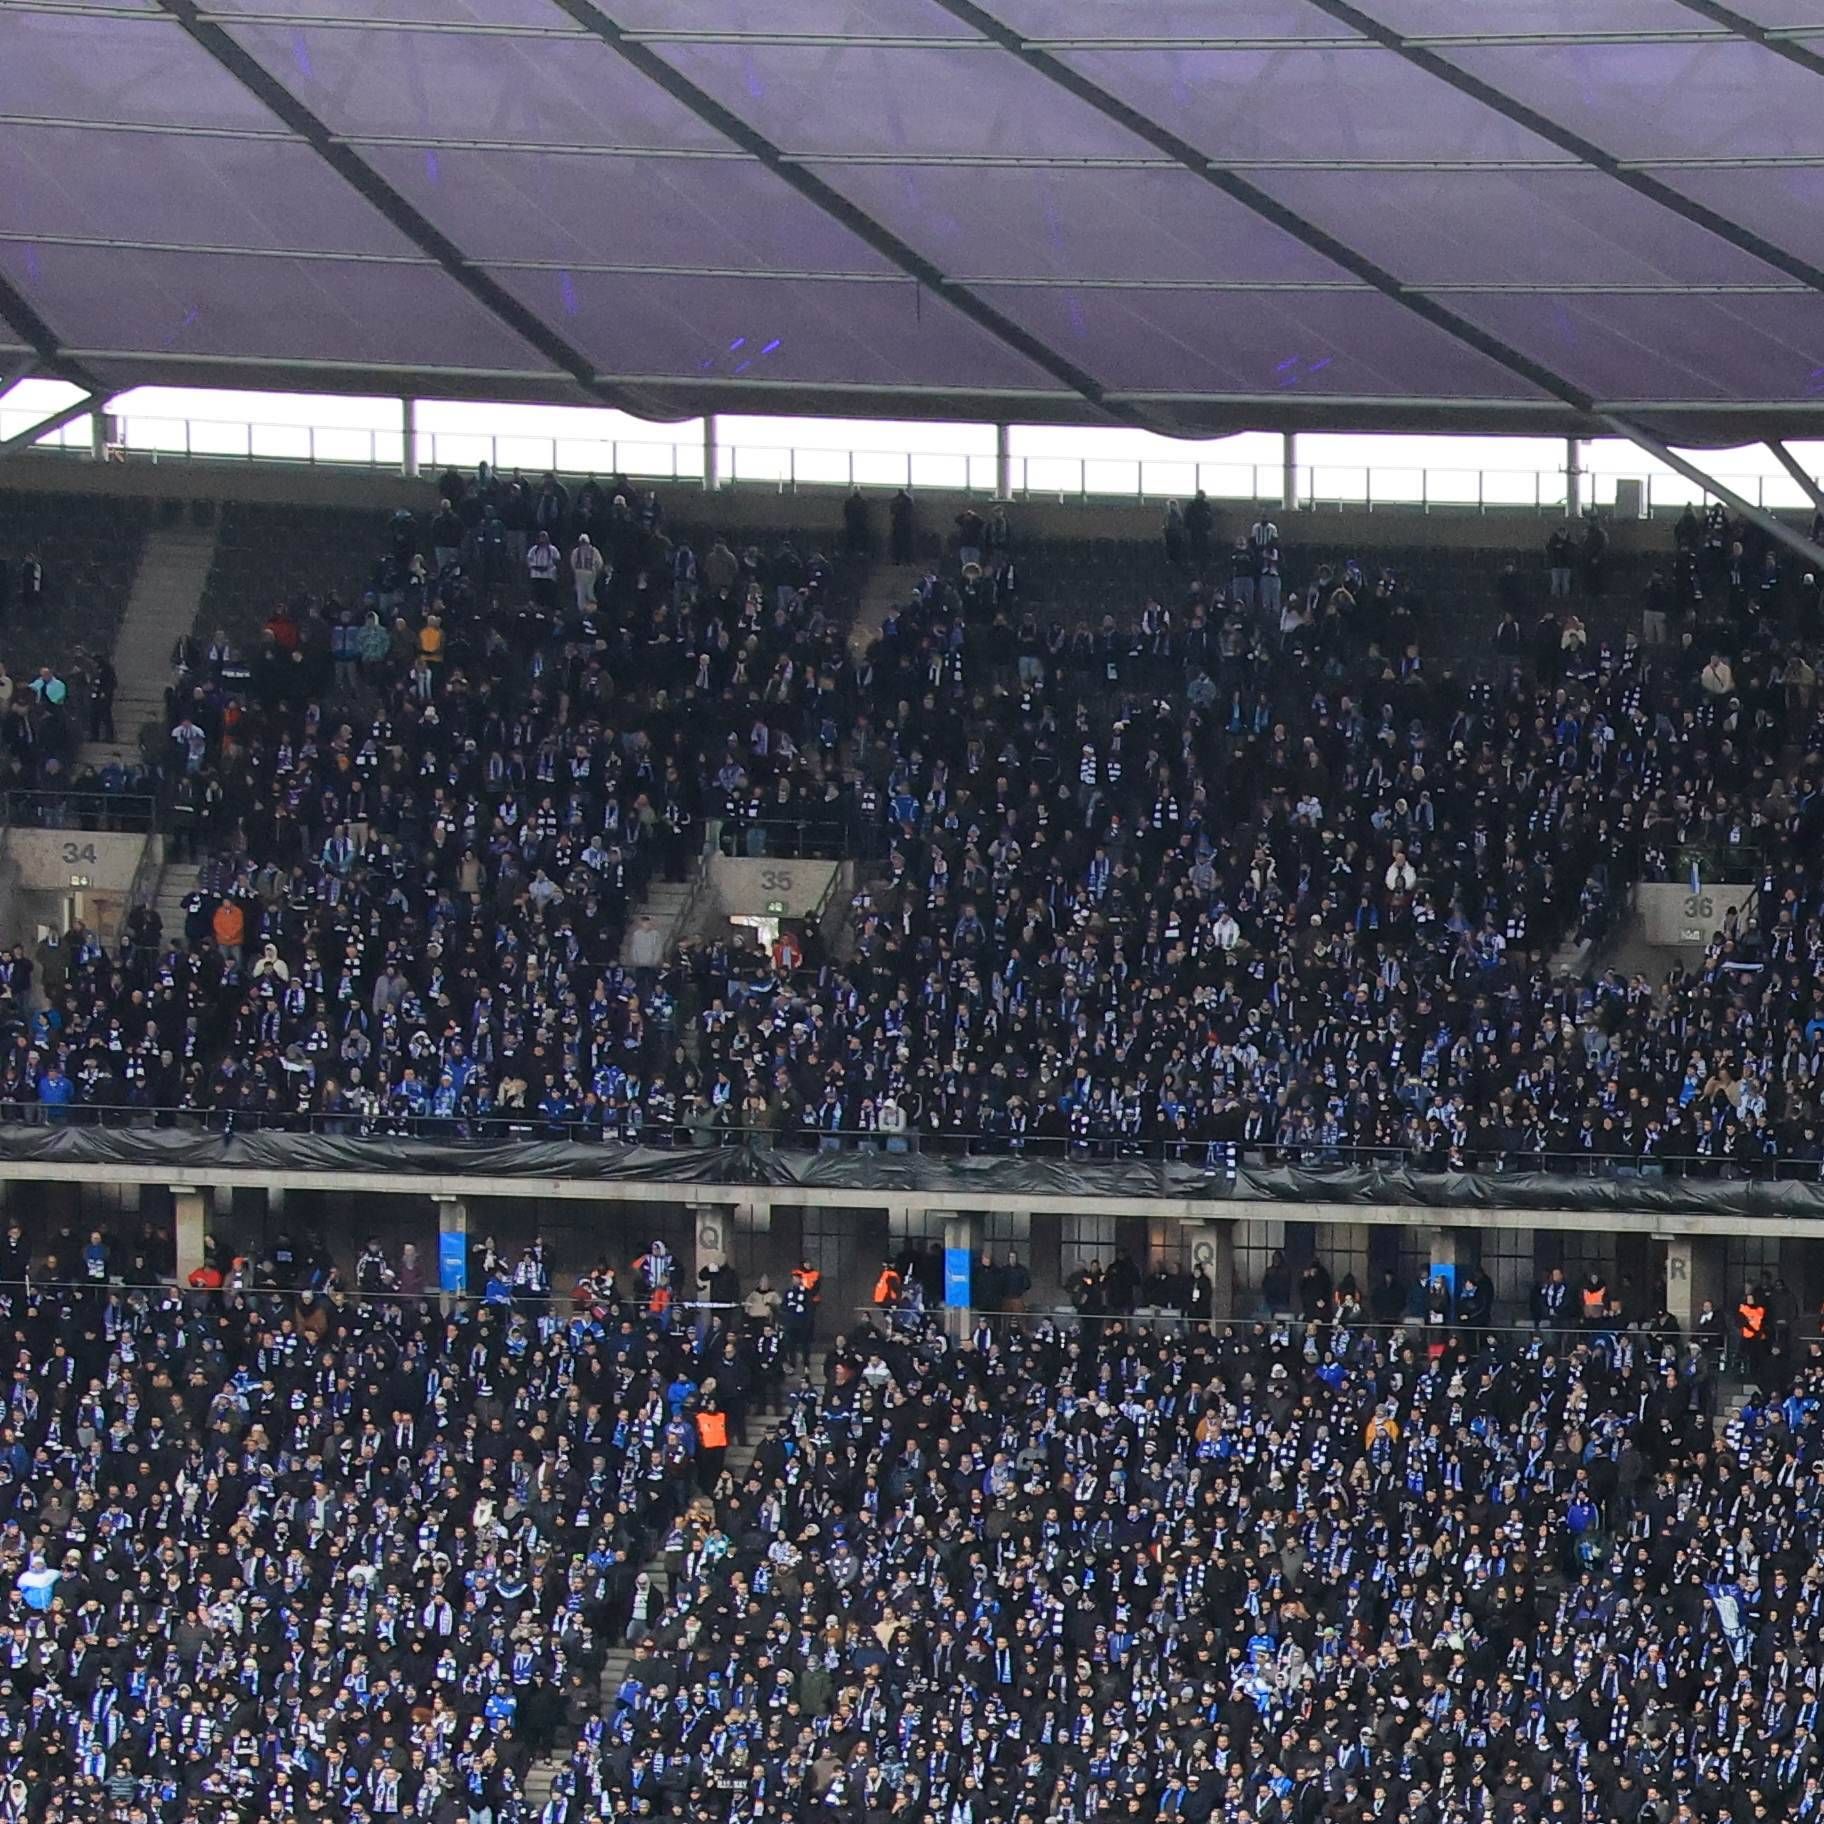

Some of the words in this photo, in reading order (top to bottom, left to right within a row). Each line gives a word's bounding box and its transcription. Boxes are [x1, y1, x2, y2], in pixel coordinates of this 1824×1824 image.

[62, 842, 97, 864] 34
[761, 869, 793, 891] 35
[1684, 896, 1714, 919] 36
[698, 1226, 719, 1251] Q
[1193, 1241, 1215, 1265] Q
[1670, 1258, 1687, 1280] R
